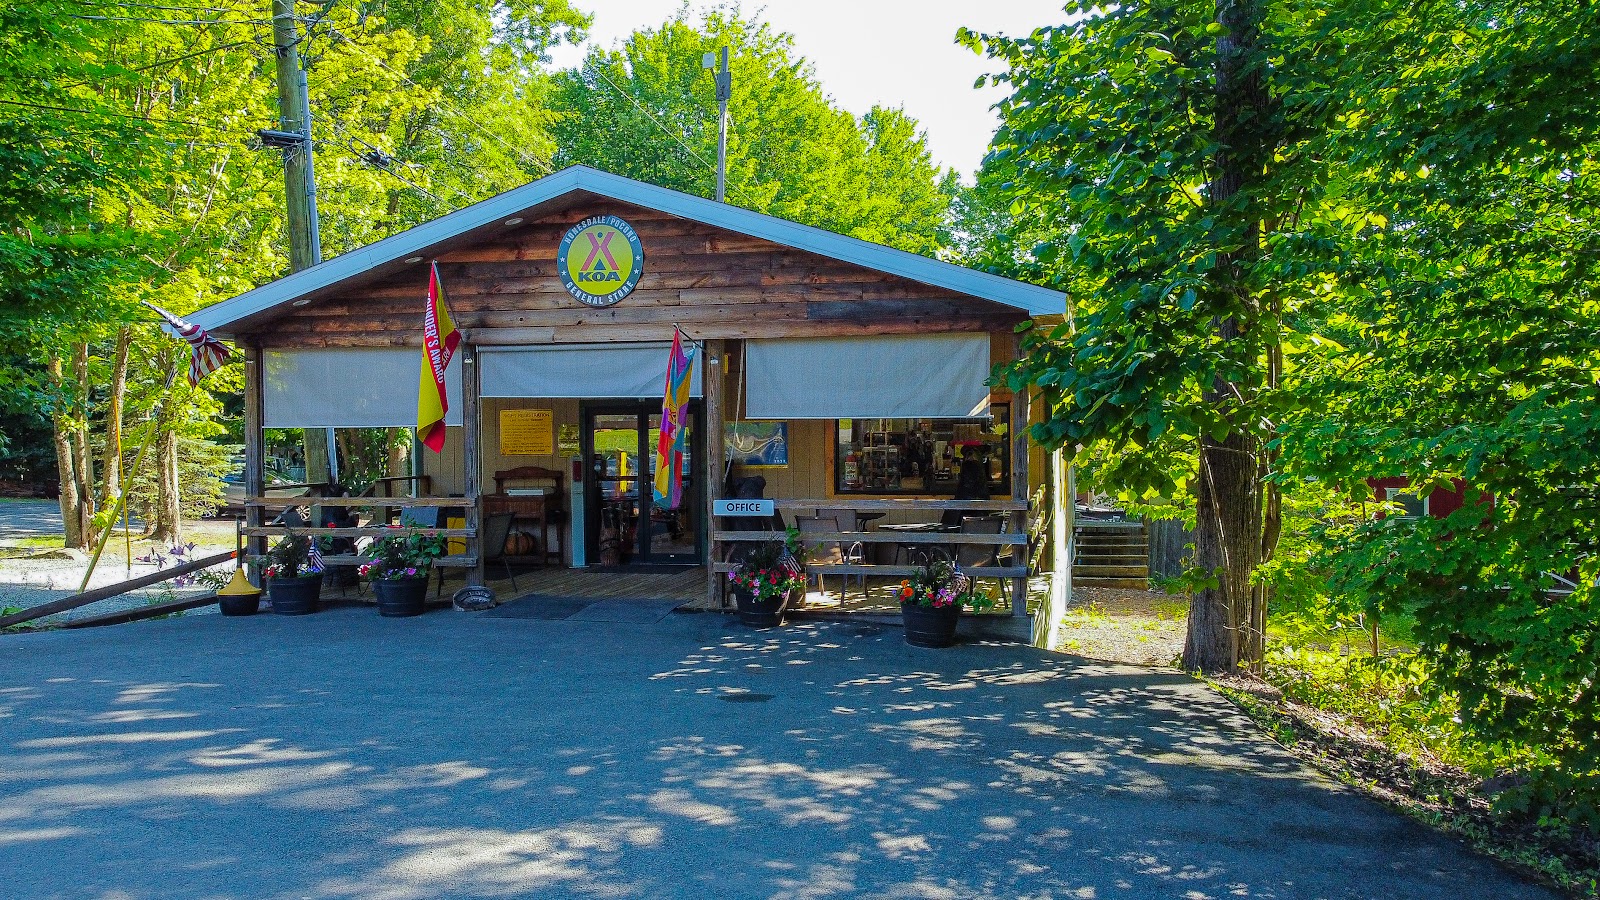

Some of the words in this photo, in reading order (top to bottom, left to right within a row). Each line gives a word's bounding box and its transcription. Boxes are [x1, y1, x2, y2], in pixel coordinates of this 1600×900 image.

[564, 215, 637, 245] HONESDALE/POCONO
[578, 271, 621, 282] KOA
[565, 281, 604, 305] GENERAL
[608, 280, 634, 303] STORE
[430, 348, 444, 384] AWARD
[726, 502, 761, 512] OFFICE
